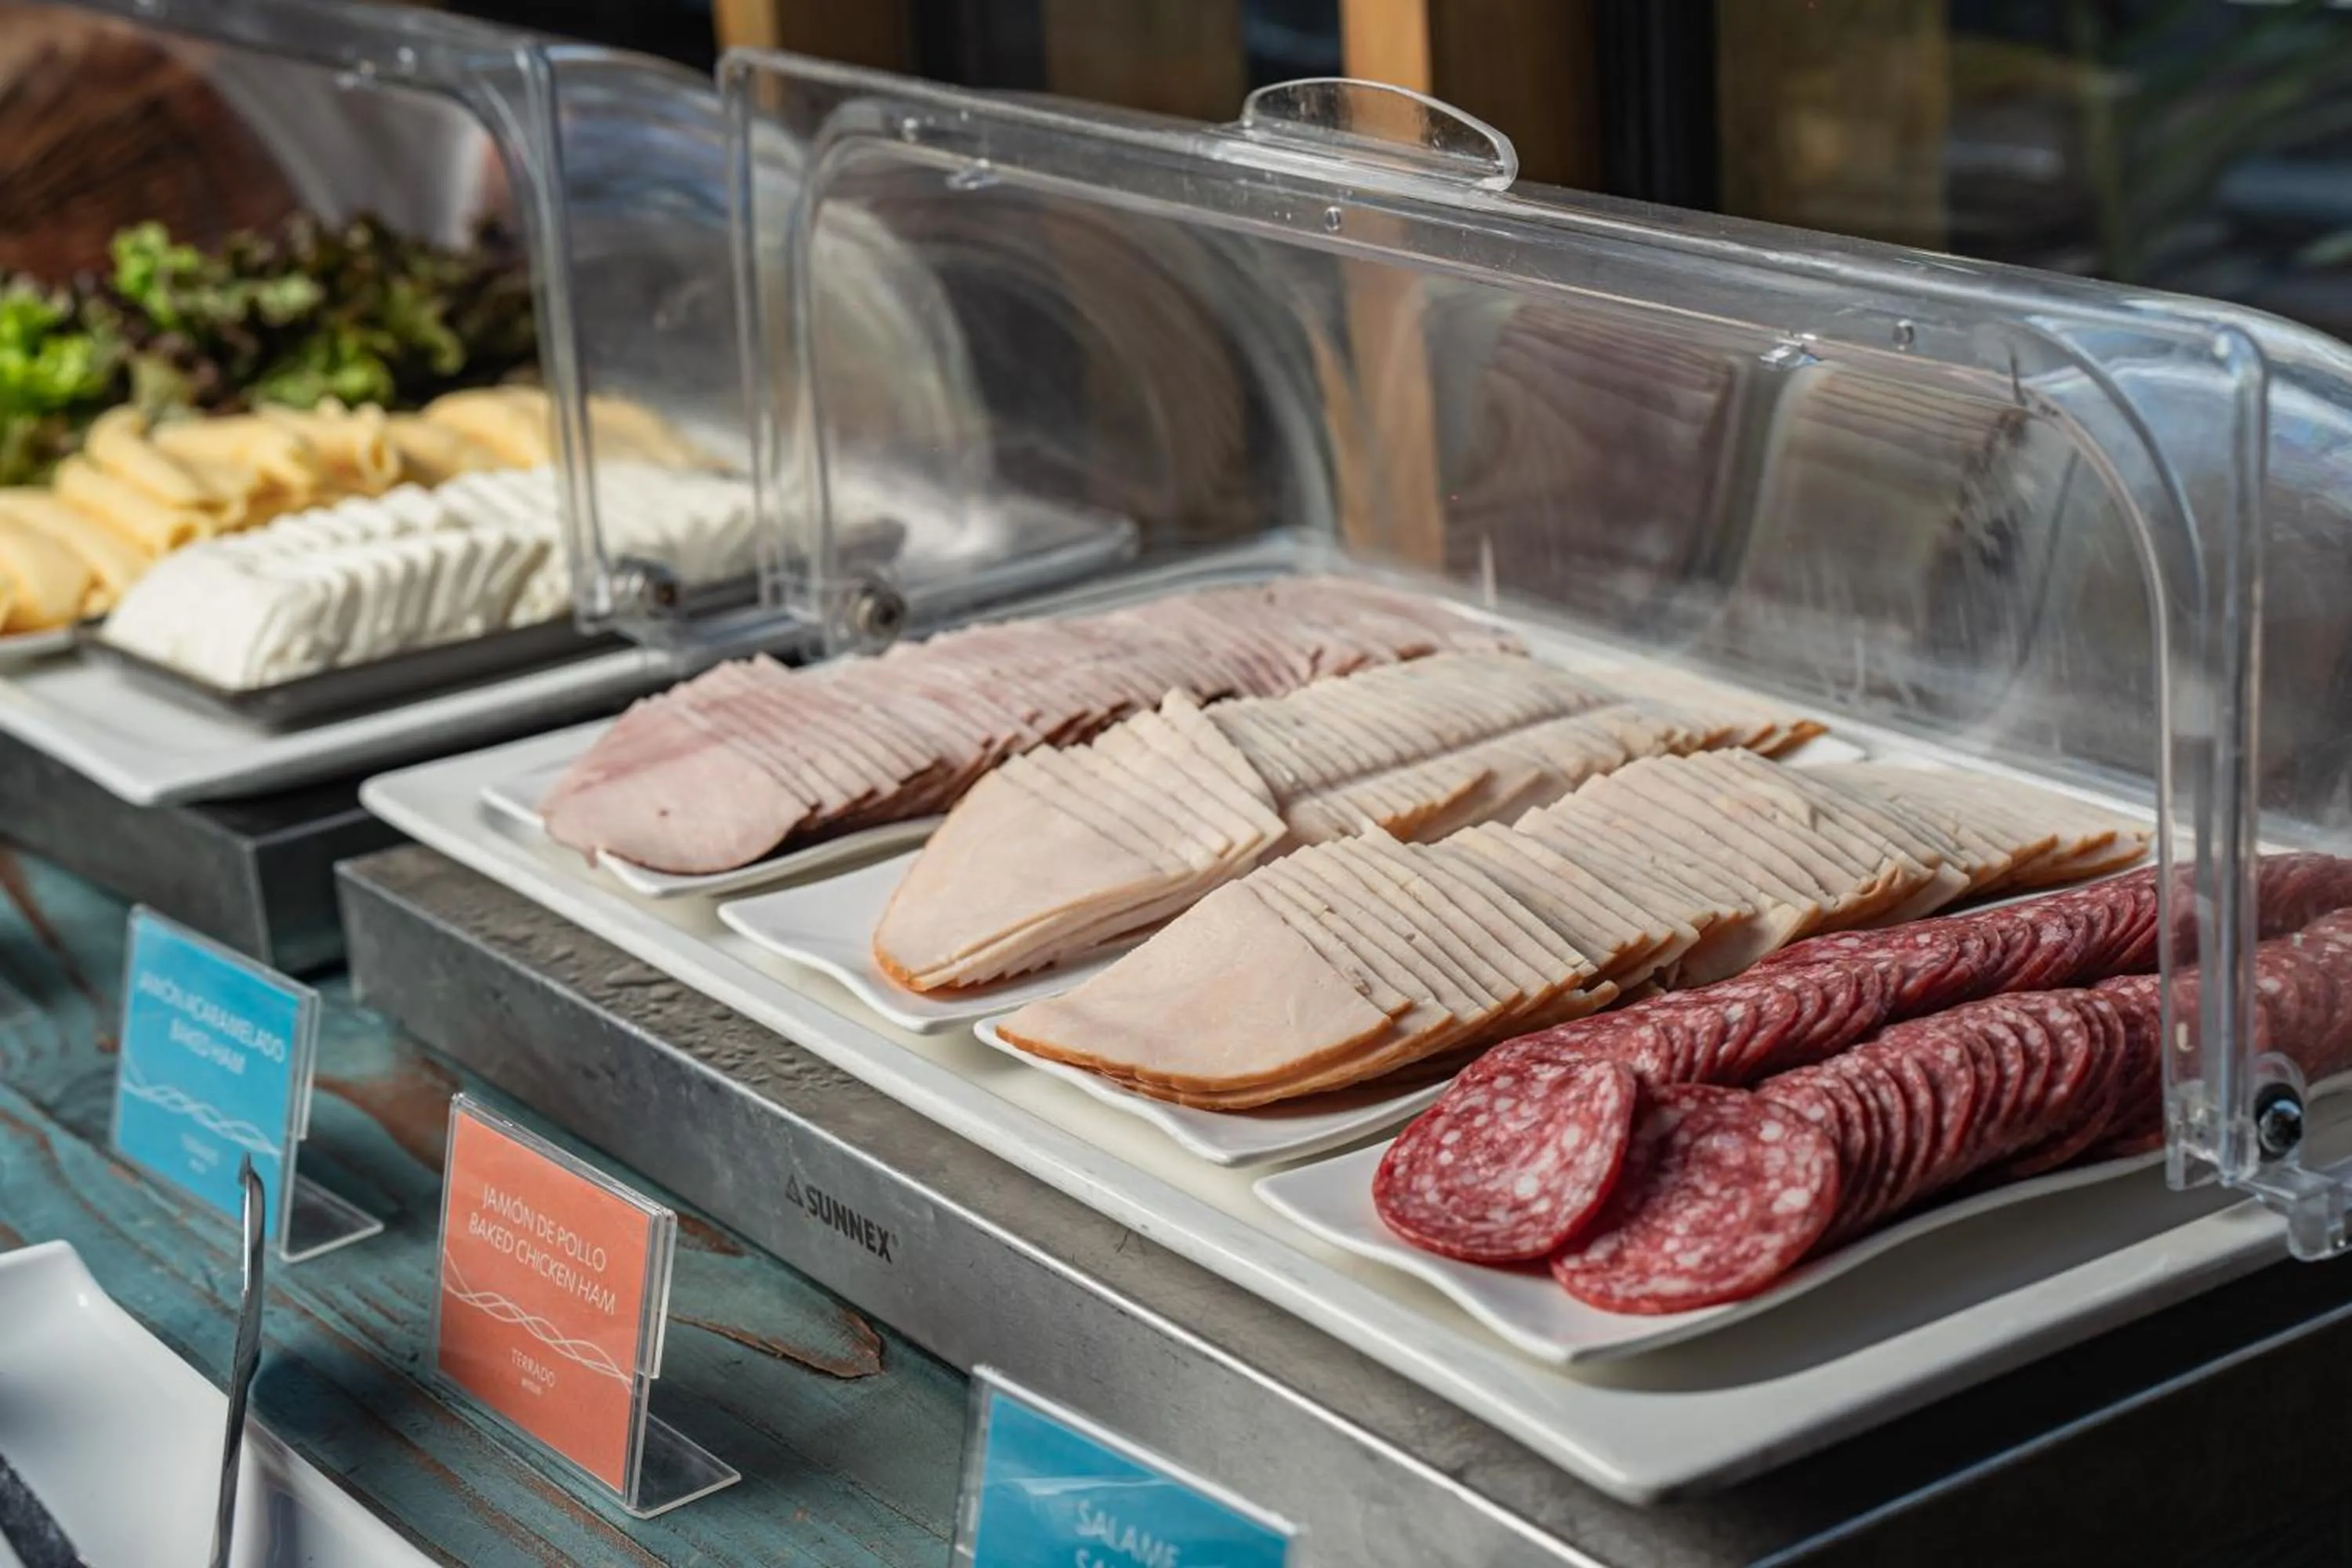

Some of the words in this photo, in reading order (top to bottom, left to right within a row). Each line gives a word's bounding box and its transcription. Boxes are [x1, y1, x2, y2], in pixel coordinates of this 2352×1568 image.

[470, 1212, 514, 1254] BAKED
[516, 1240, 576, 1293] CHICKEN
[578, 1276, 615, 1315] HAM
[482, 1184, 535, 1232] JAMÓN
[537, 1214, 556, 1244] DE
[557, 1226, 606, 1272] POLLO
[805, 1185, 892, 1265] SUNNEX
[511, 1348, 556, 1388] TERRADO
